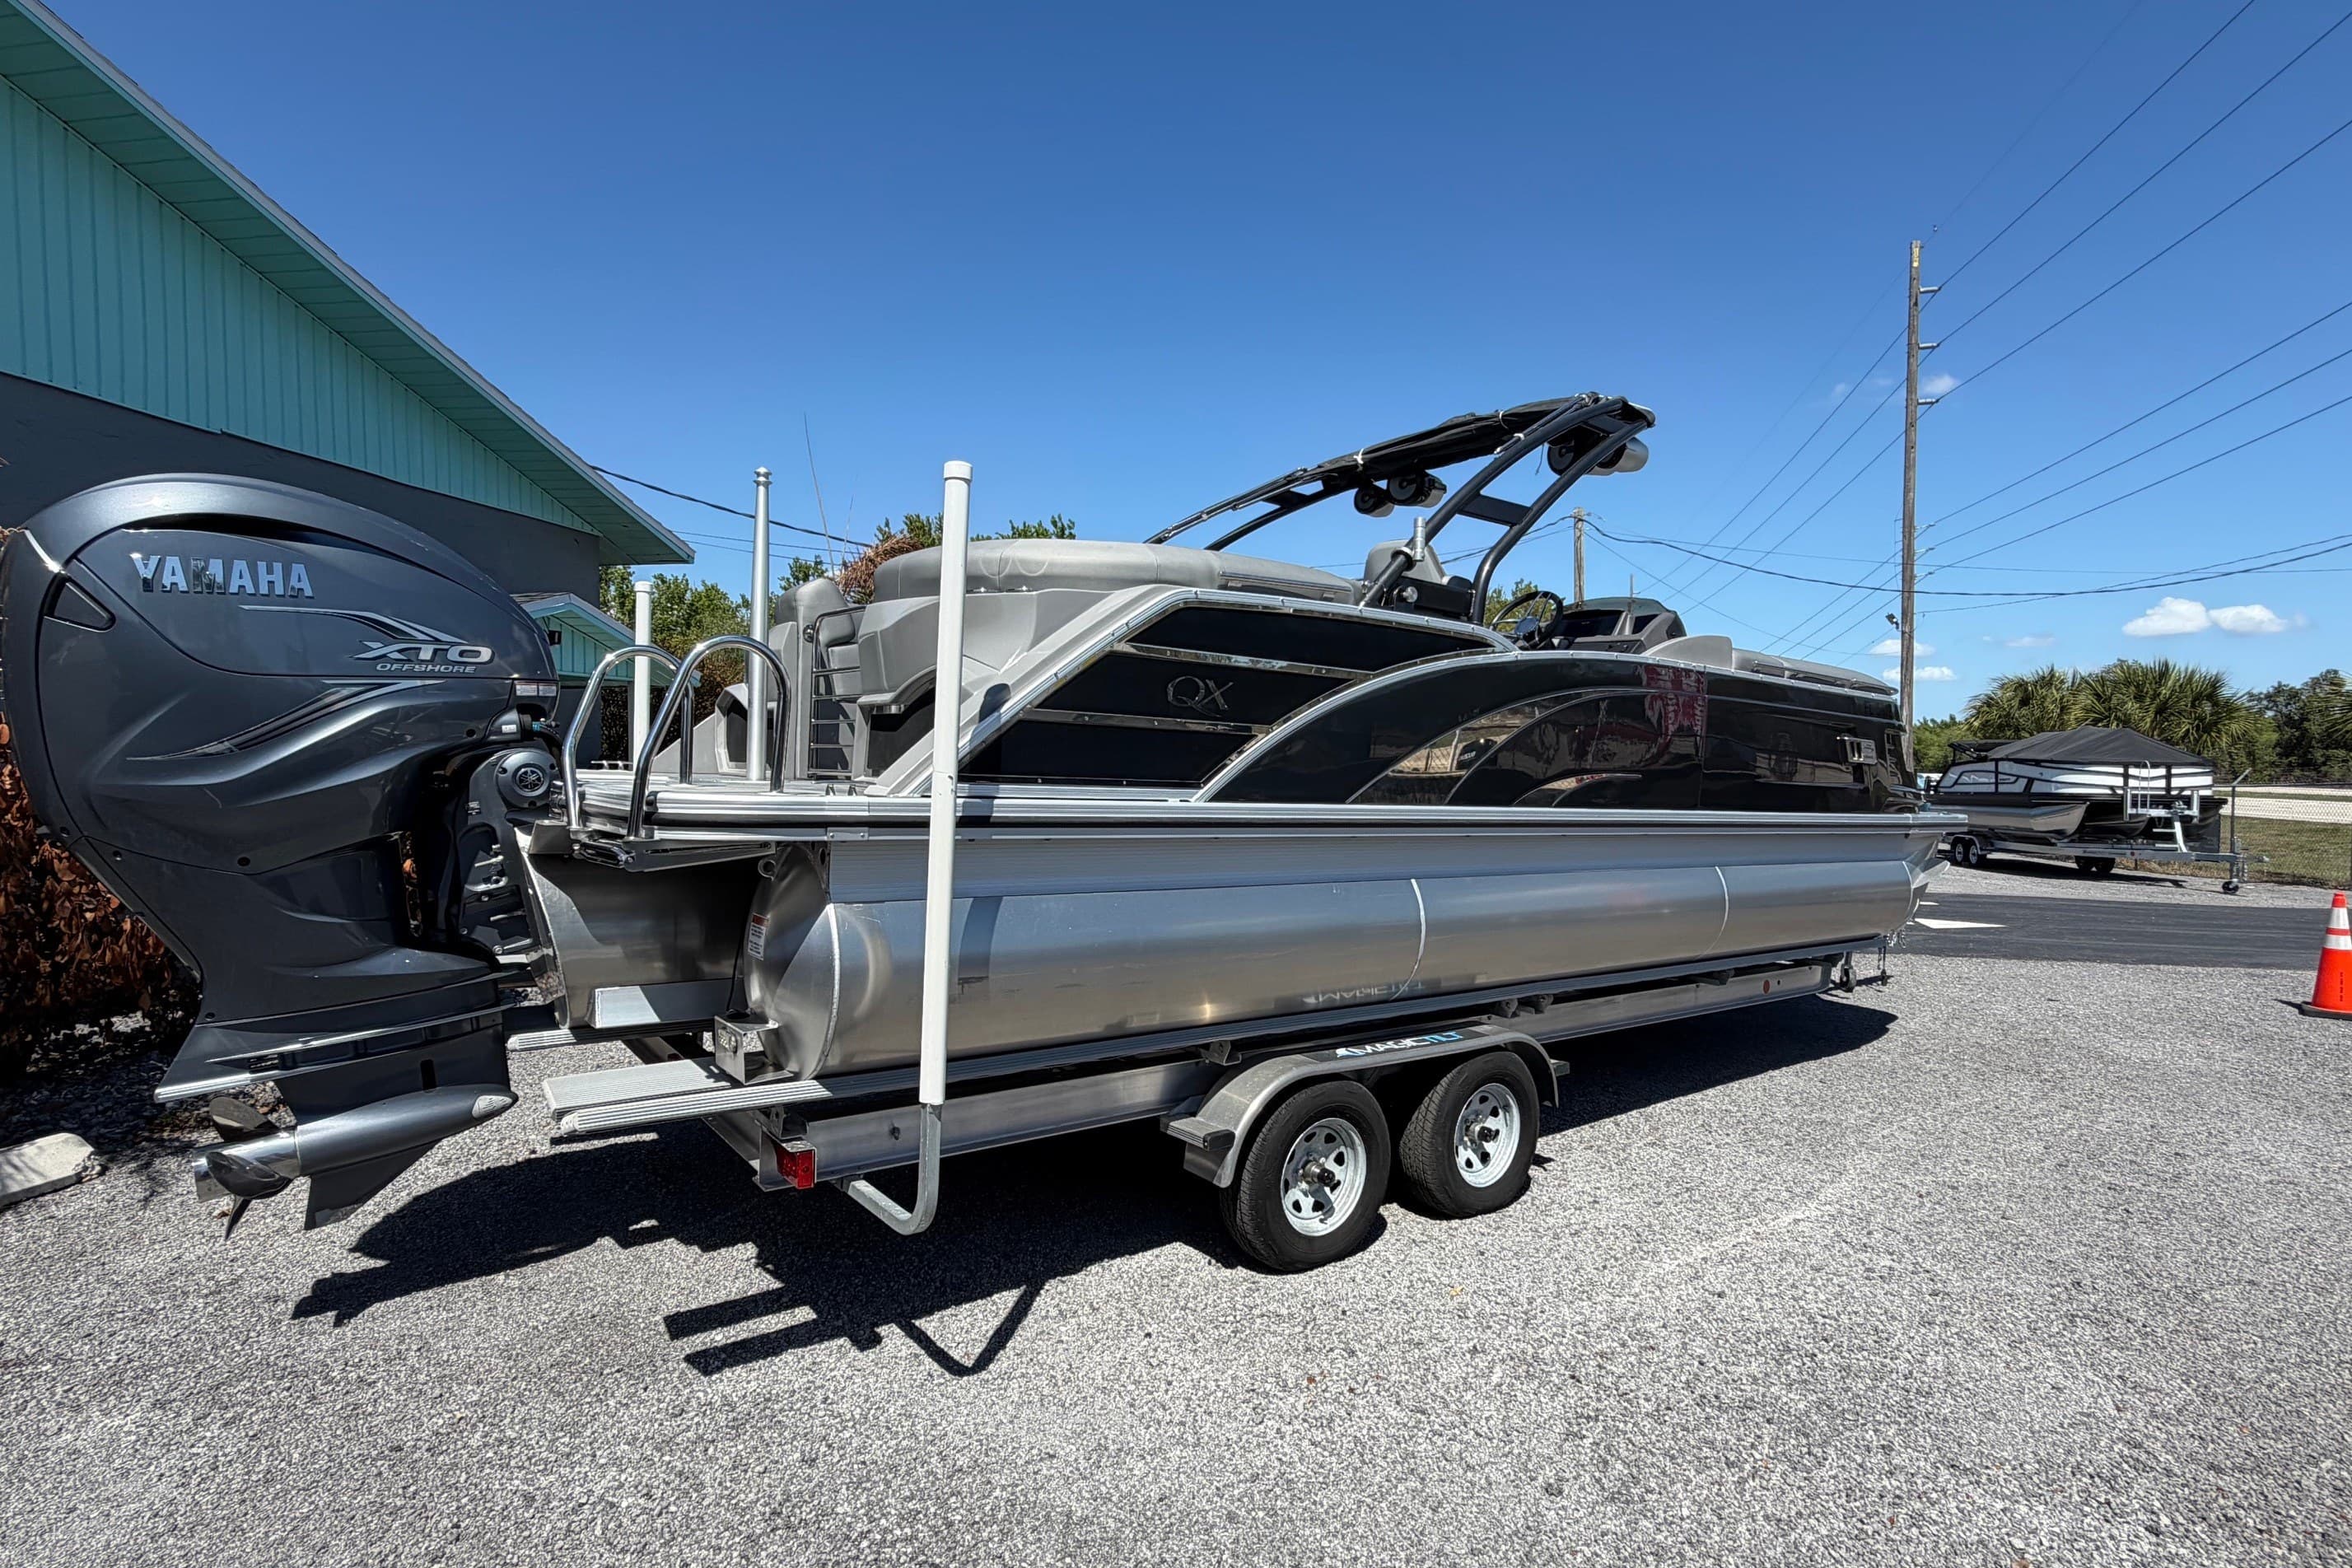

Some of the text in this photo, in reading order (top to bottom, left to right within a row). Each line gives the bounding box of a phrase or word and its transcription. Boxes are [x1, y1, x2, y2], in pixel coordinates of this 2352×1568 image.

[129, 553, 314, 597] YAMAHA
[352, 641, 493, 664] XTO
[376, 662, 478, 674] OFFSHORE
[1166, 675, 1234, 717] QX
